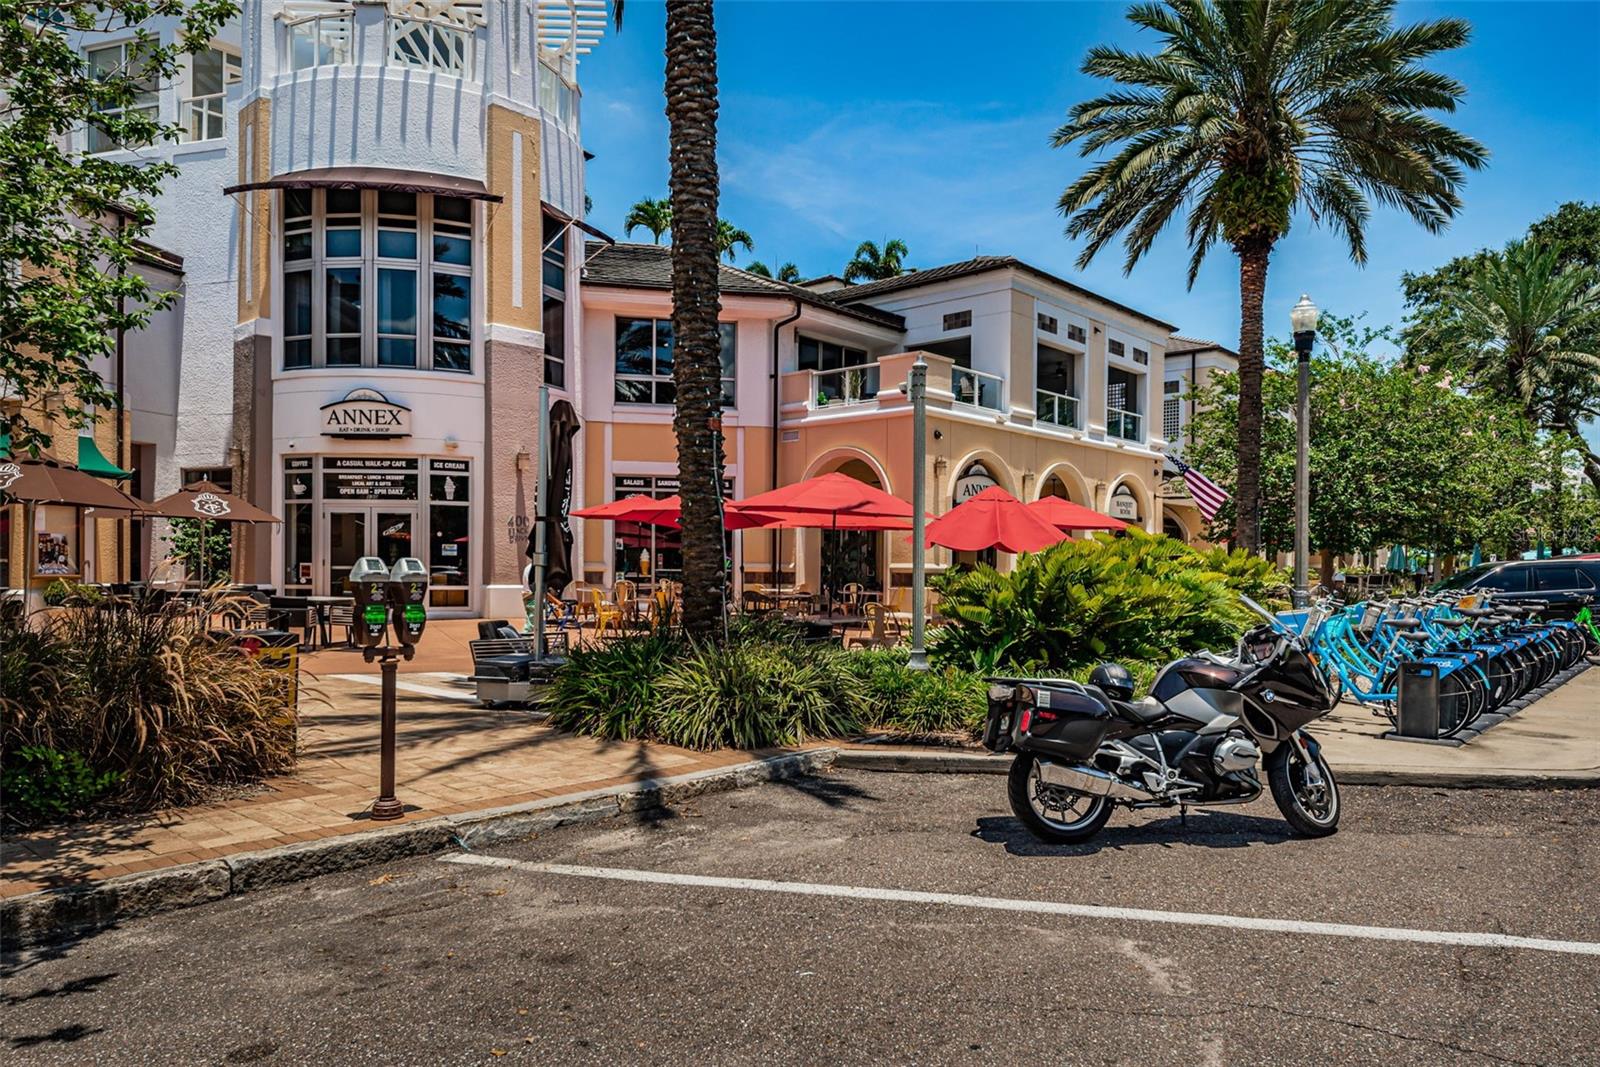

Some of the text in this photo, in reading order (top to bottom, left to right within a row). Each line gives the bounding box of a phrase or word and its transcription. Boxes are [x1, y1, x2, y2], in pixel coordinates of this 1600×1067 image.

[327, 409, 402, 425] ANNEX
[963, 484, 989, 496] ANN
[370, 583, 377, 593] 2
[410, 583, 417, 593] 2
